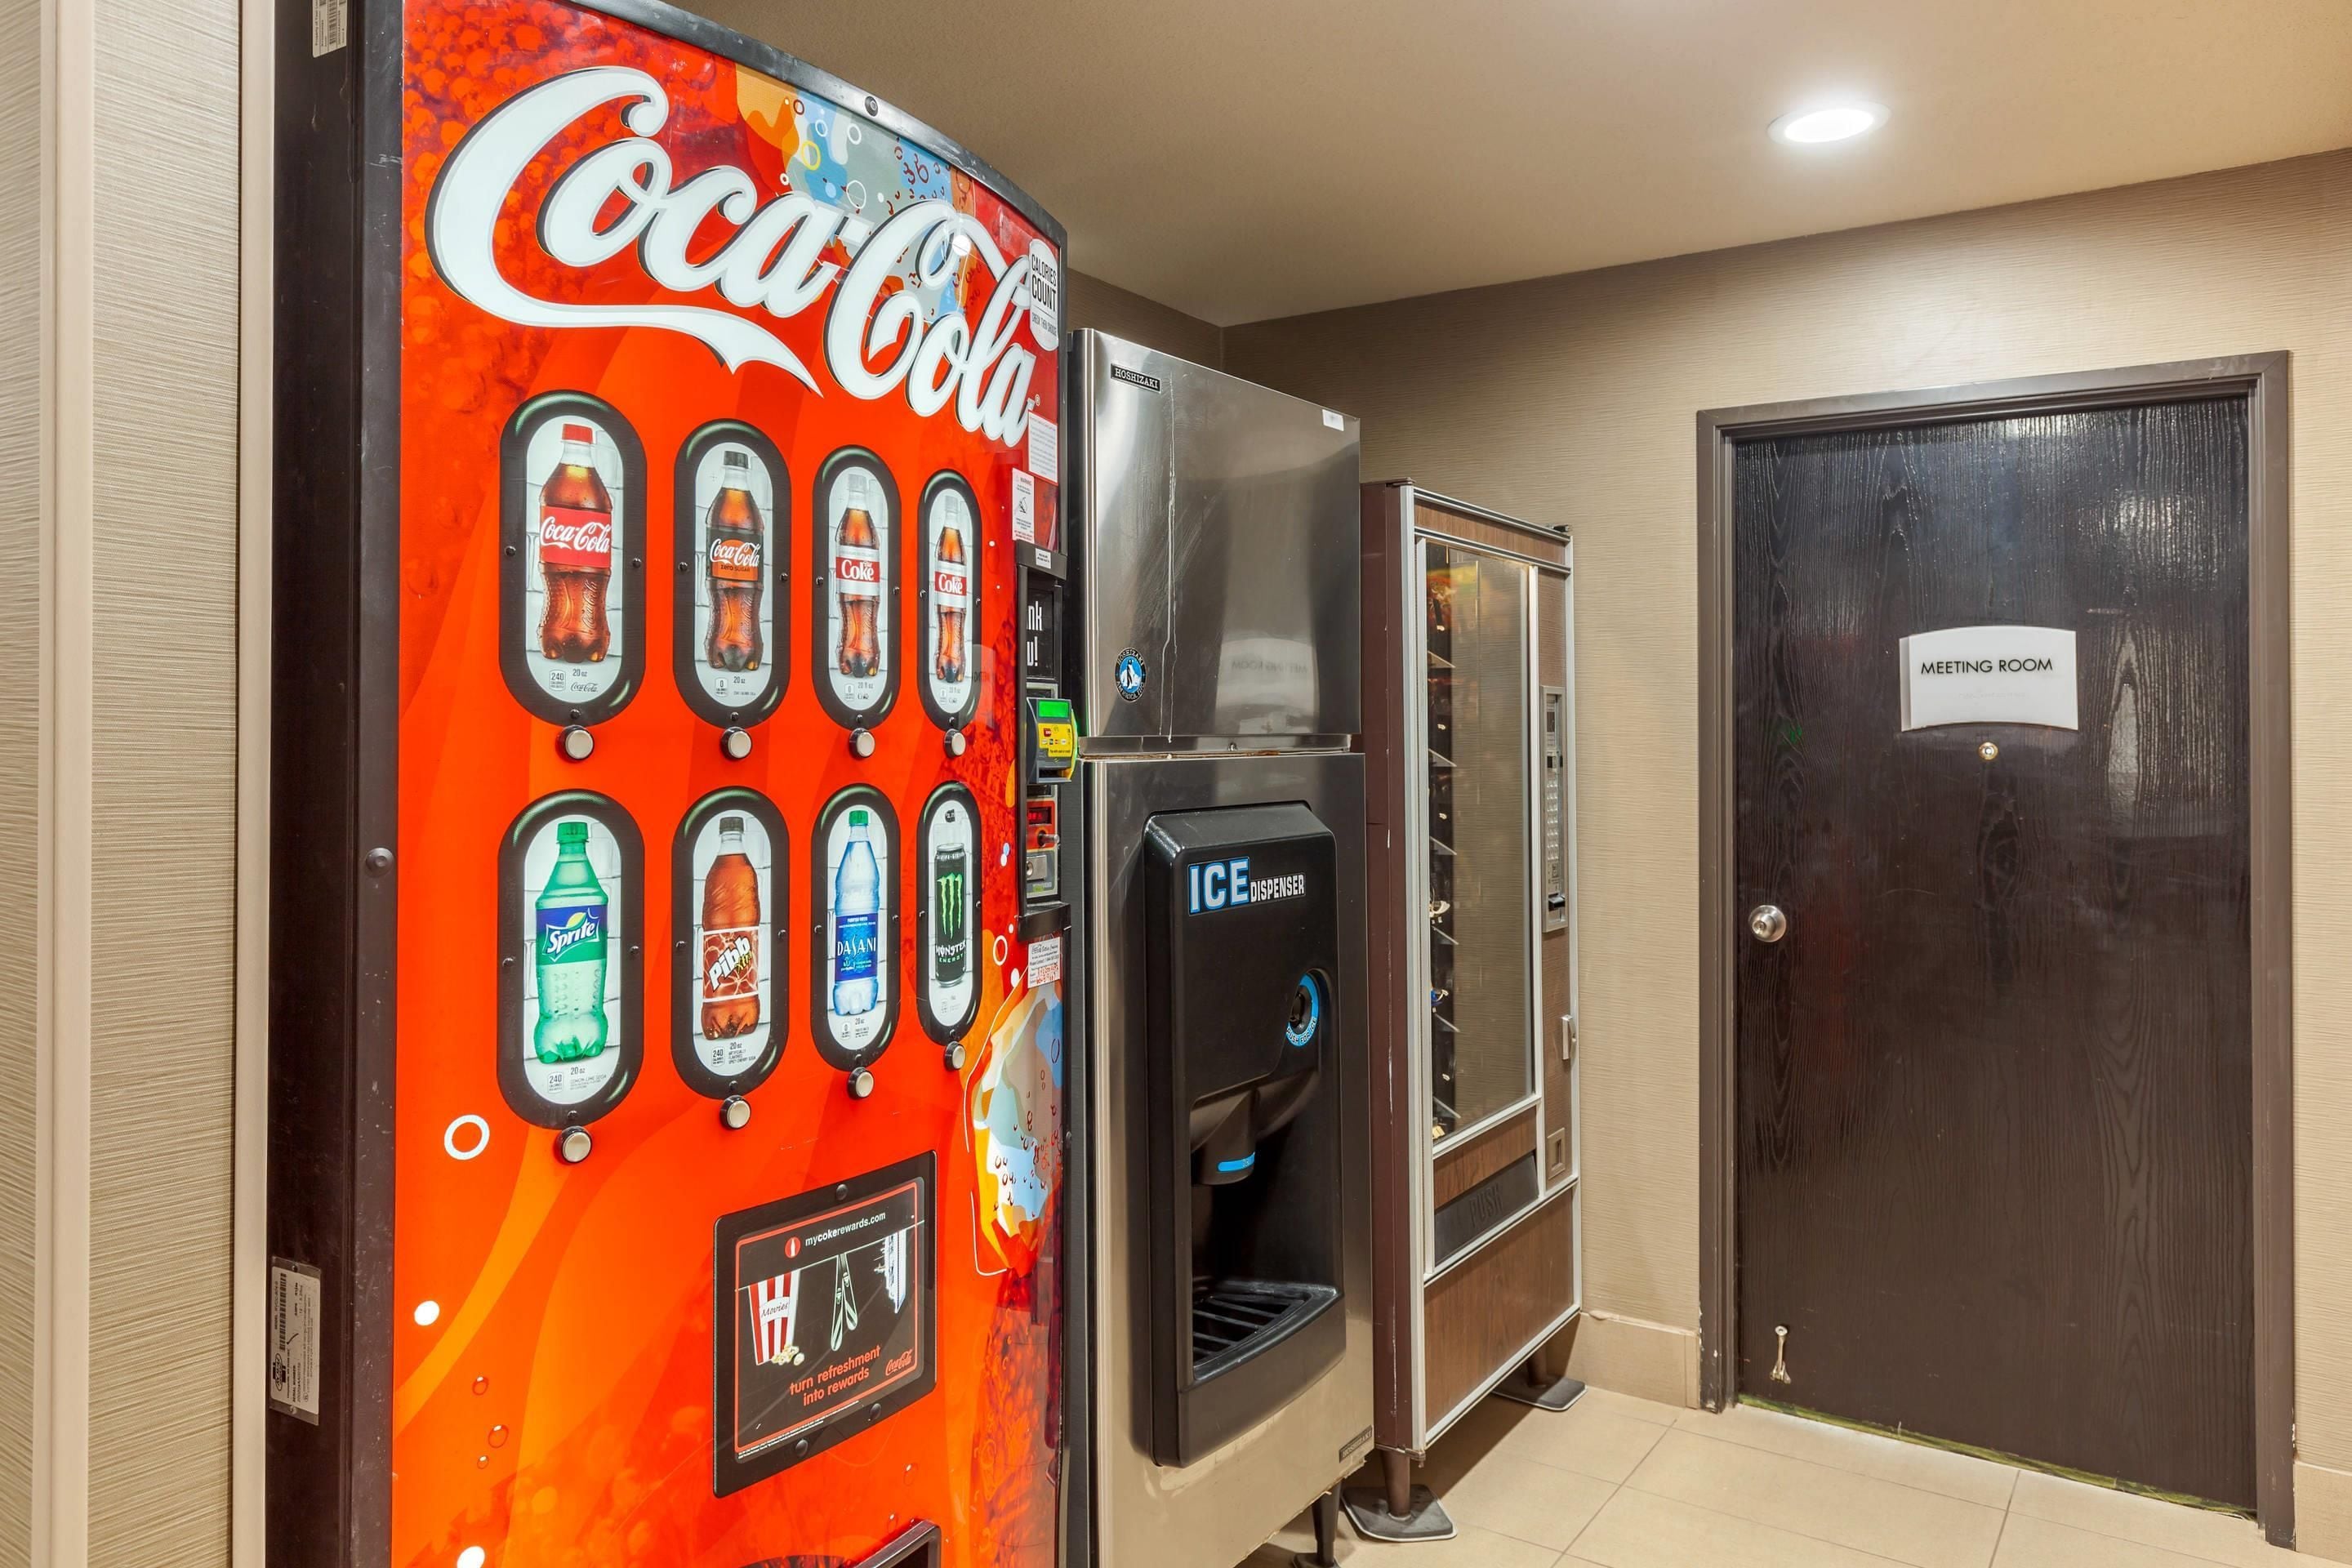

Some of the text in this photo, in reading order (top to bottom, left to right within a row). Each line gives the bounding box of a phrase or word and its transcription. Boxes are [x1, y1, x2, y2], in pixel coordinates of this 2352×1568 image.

[425, 65, 1036, 448] Coca-Cola
[1031, 254, 1057, 287] CALORIES
[1031, 274, 1057, 312] COUNT
[1115, 368, 1158, 389] HOSHIZAKI
[540, 516, 612, 553] Coca-Cola
[710, 538, 761, 567] Coca-Cola
[841, 559, 874, 581] Coke
[938, 573, 963, 594] Coke
[1027, 601, 1043, 631] nk
[550, 673, 564, 681] 240
[572, 669, 581, 677] 20
[1921, 658, 2053, 674] MEETING ROOM
[571, 682, 599, 693] Coca-Cola
[1190, 858, 1305, 914] ICE DISPENSER
[547, 919, 595, 954] Sprite
[837, 934, 875, 956] DASANI
[936, 939, 965, 957] MONSTER
[713, 1049, 724, 1058] 240
[549, 1075, 562, 1084] 240
[571, 1067, 578, 1075] 20
[1469, 1183, 1503, 1228] PUSH
[805, 1212, 886, 1247] mycokerewards.com
[761, 1302, 789, 1317] Movies
[790, 1345, 880, 1395] turn refreshment
[885, 1348, 913, 1376] Coca-Cola
[804, 1367, 869, 1406] into rewards
